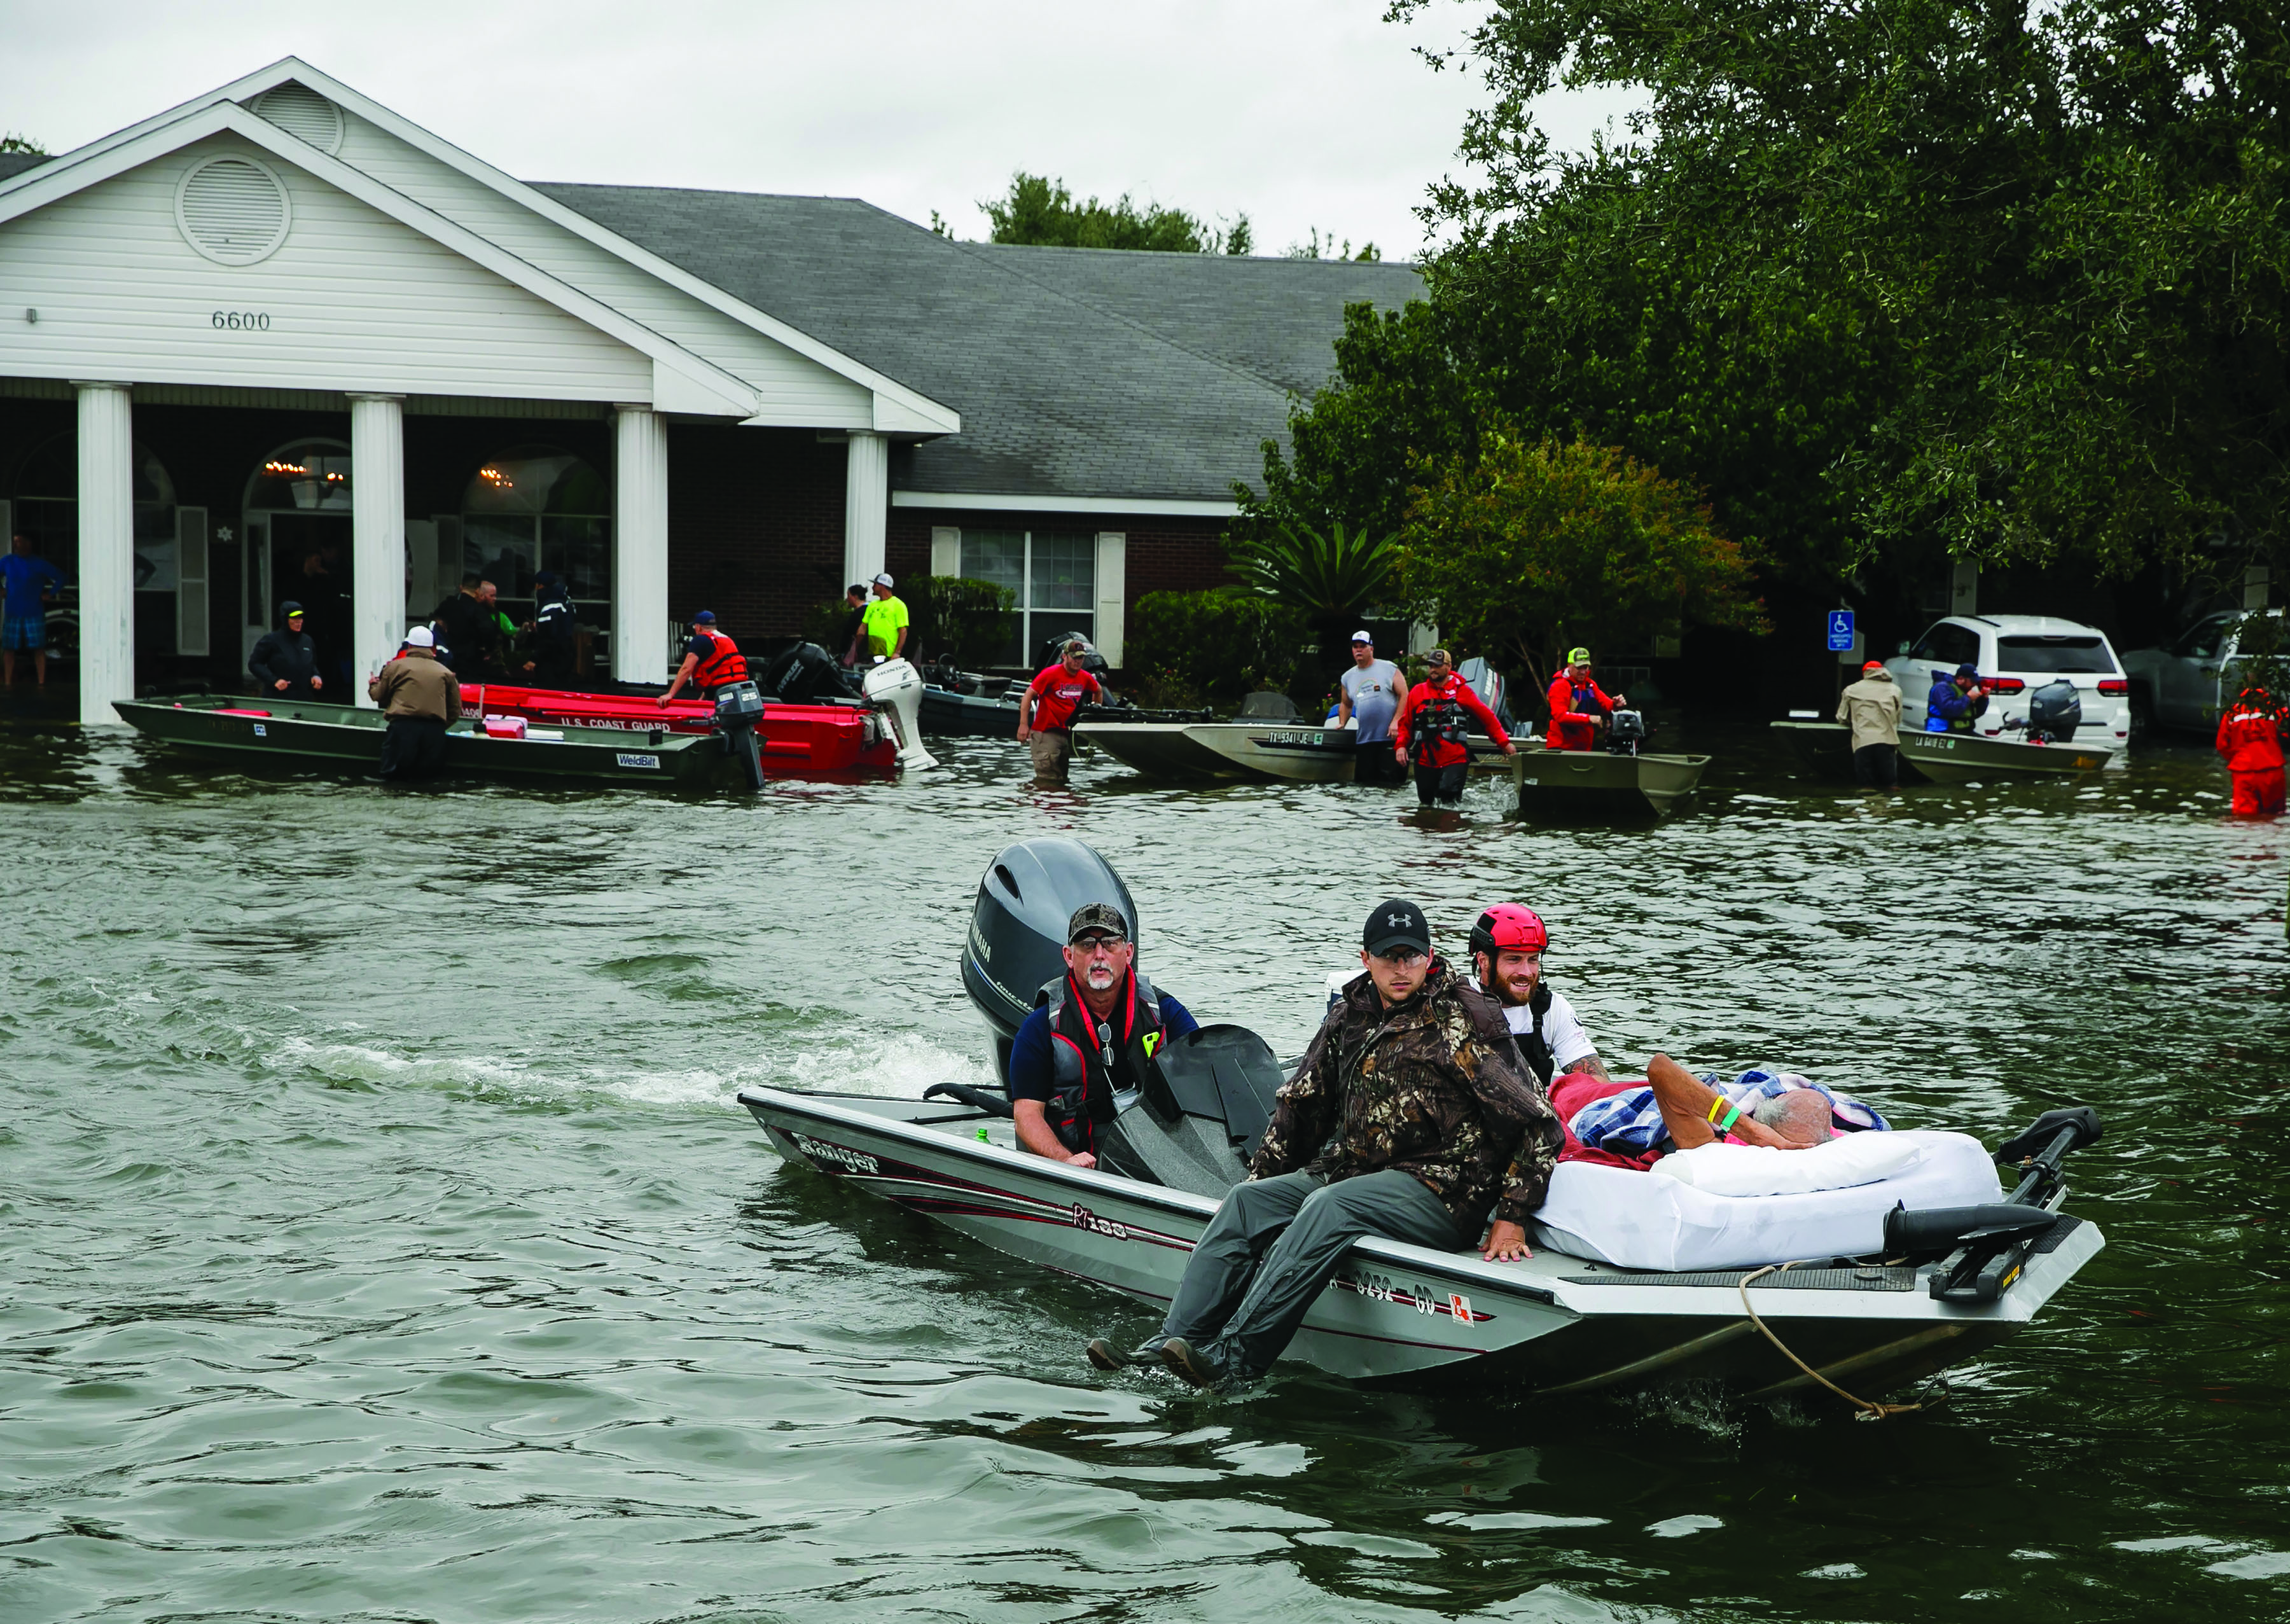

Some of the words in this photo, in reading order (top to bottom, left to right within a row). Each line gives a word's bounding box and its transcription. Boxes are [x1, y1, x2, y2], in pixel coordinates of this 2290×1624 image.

[212, 310, 270, 331] 6600
[877, 665, 907, 677] HONDA
[741, 691, 758, 702] 25
[590, 719, 625, 730] COAST
[632, 721, 670, 733] GUARD
[1269, 732, 1278, 743] TX
[619, 754, 656, 767] WeldBilt
[791, 1132, 879, 1174] Ranger
[1355, 1270, 1394, 1303] 8252
